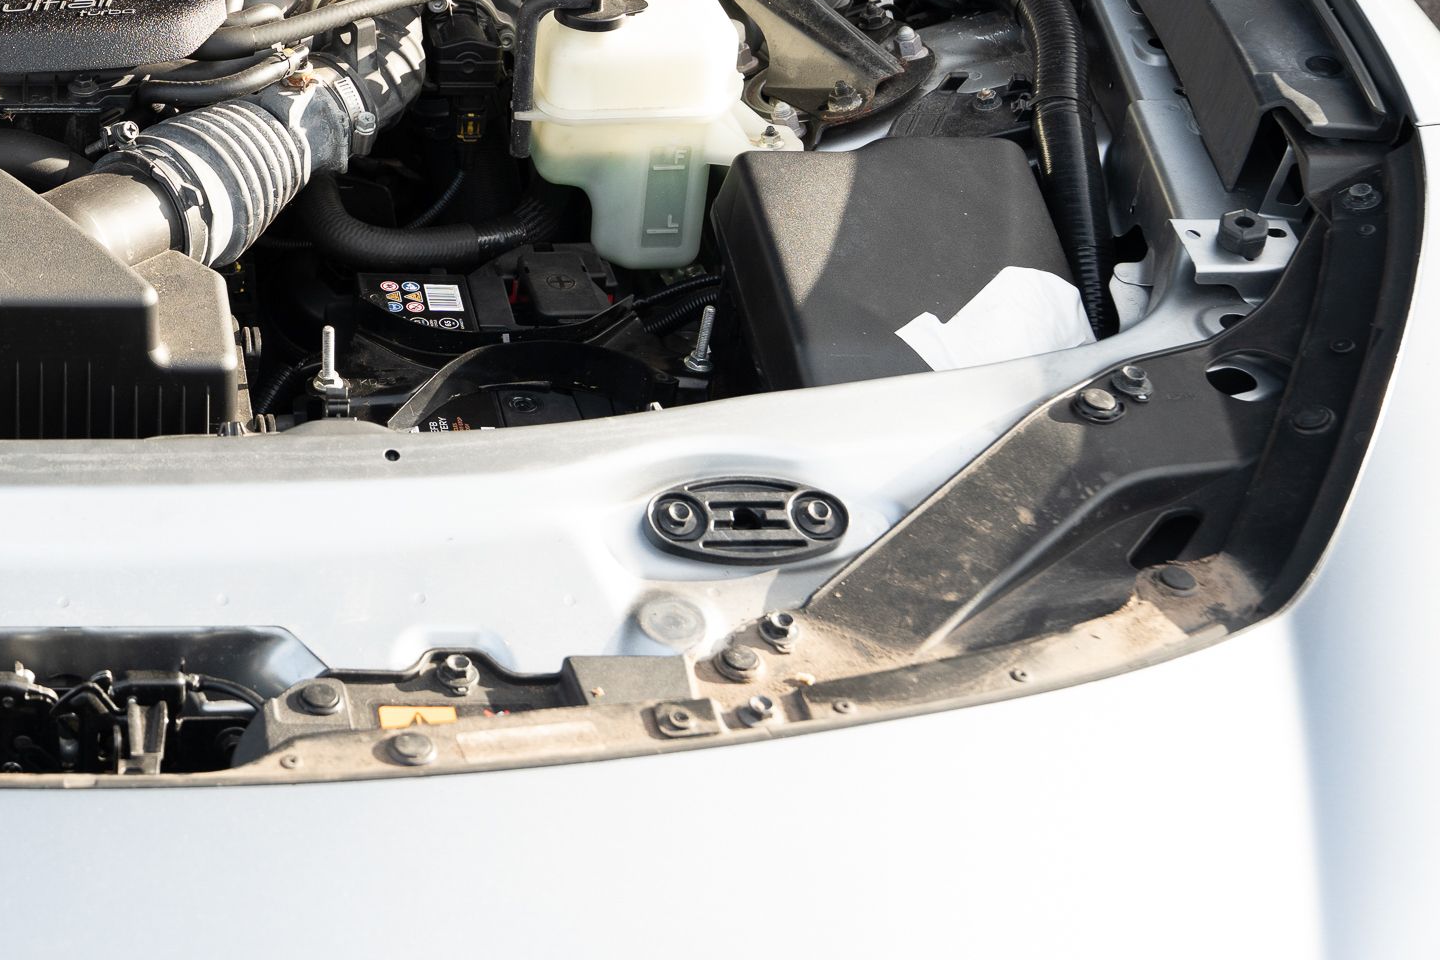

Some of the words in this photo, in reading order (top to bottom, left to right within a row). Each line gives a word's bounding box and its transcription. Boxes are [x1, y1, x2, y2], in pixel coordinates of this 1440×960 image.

[79, 8, 136, 17] turbo
[674, 149, 688, 164] F
[668, 214, 679, 227] L
